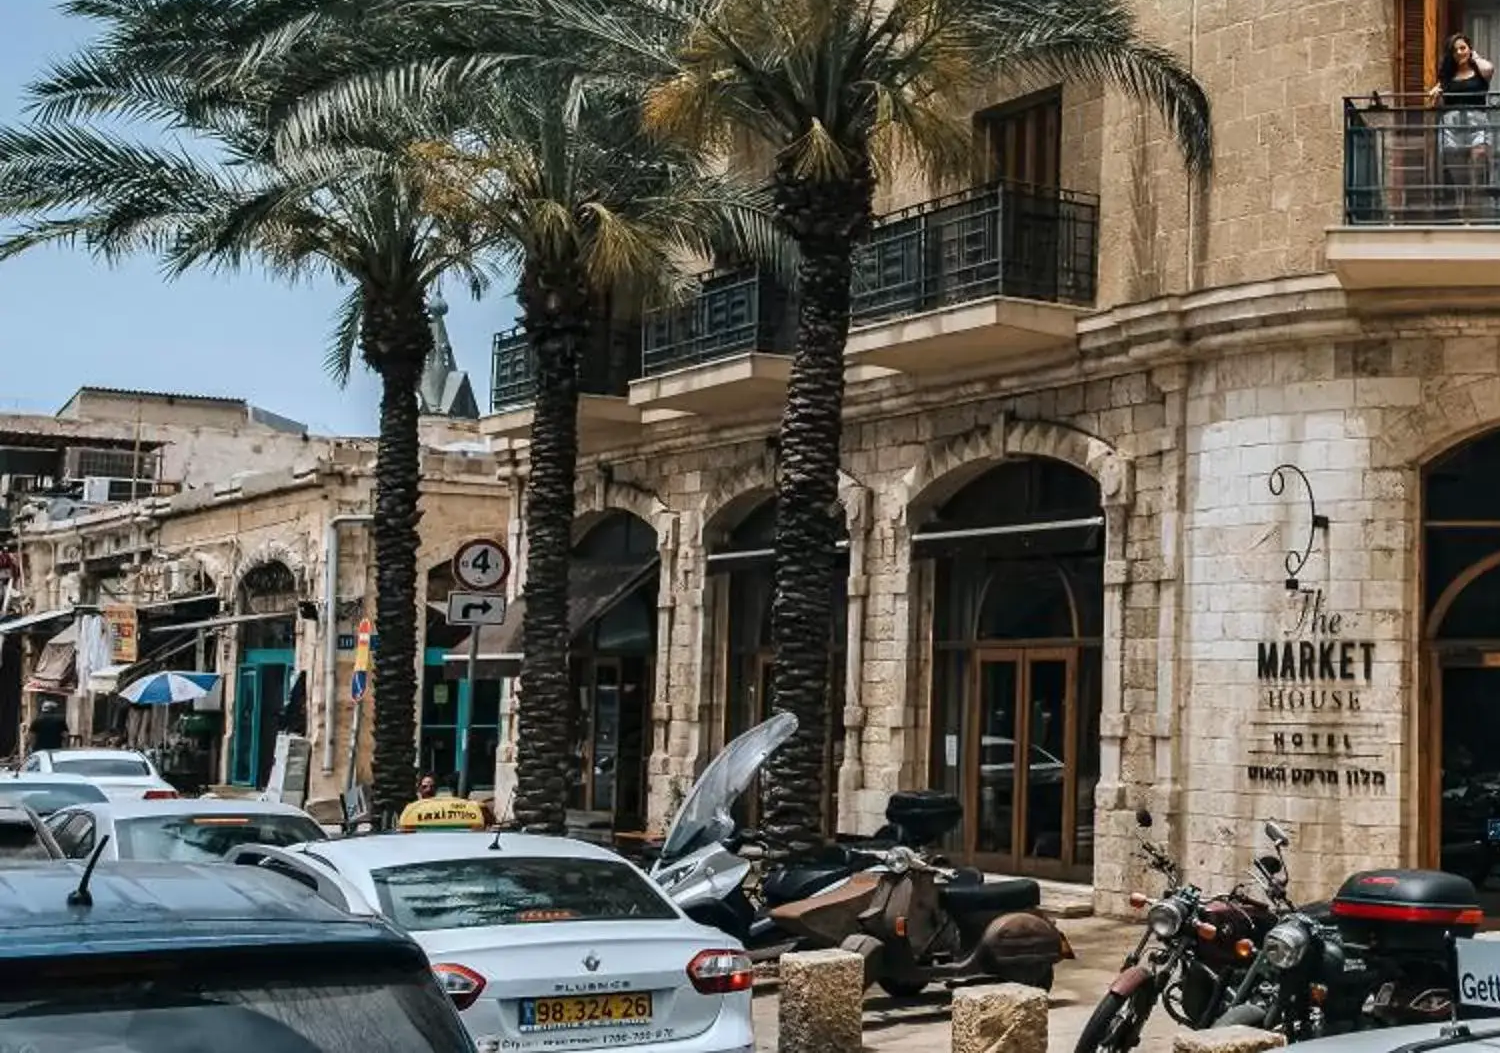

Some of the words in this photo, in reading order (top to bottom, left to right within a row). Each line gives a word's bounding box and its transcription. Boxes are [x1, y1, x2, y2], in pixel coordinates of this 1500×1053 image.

[472, 548, 491, 574] 4
[1284, 588, 1341, 637] The
[1257, 641, 1376, 681] MARKET
[1268, 690, 1361, 711] HOUSE
[1273, 732, 1352, 750] HOTEL
